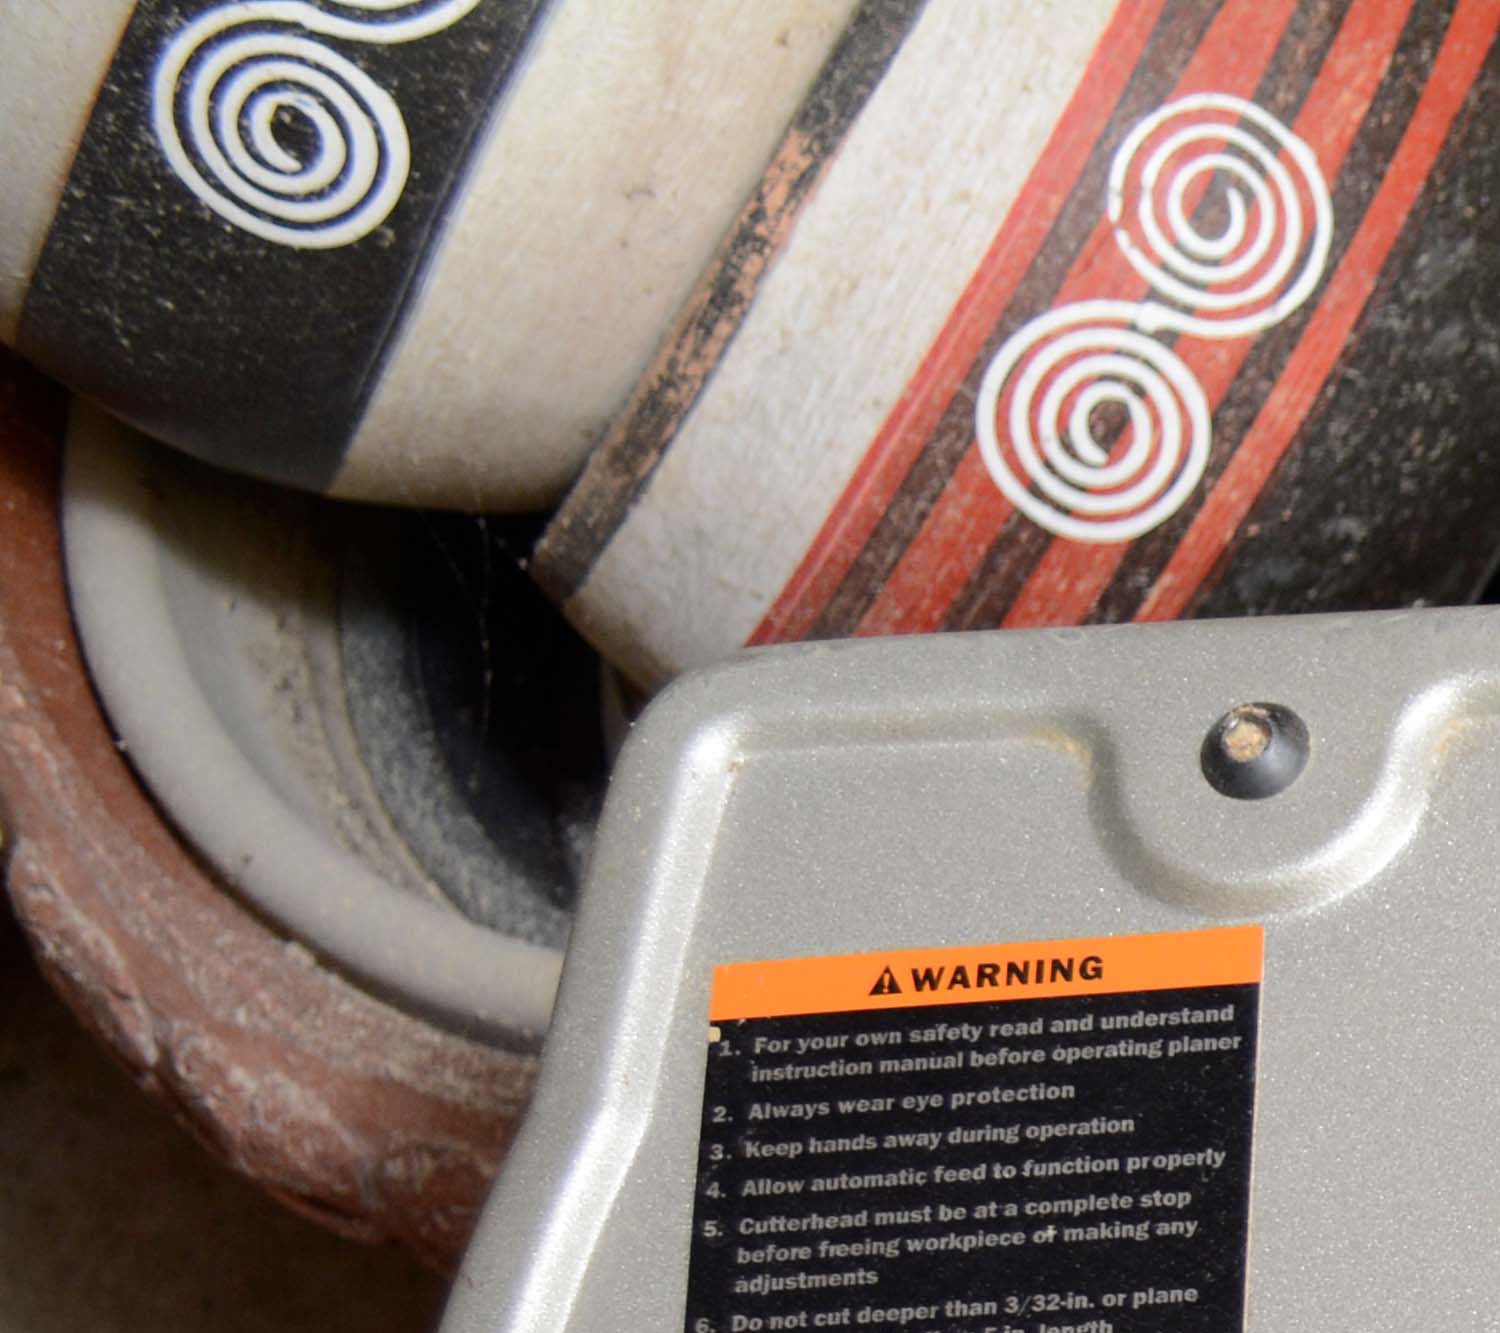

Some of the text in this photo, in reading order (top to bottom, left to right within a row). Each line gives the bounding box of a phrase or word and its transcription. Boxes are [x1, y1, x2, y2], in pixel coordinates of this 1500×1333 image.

[911, 955, 1103, 992] WARNING
[719, 1004, 1234, 1057] 1. For your own safety read and understand
[751, 1035, 1242, 1083] instruction manual before operating planer
[712, 1082, 1075, 1123] 2. Always wear eye protection
[709, 1116, 1135, 1161] 3. Keep hands away during operation
[705, 1148, 1226, 1199] 4. Allow automatic feed to function properly
[703, 1190, 1192, 1238] 5. Cutterhead must be at a complete stop
[736, 1244, 812, 1264] before
[818, 1237, 901, 1258] freeing
[906, 1229, 1026, 1253] workpiece
[1063, 1220, 1150, 1242] making
[1155, 1220, 1198, 1238] any
[734, 1268, 879, 1296] adjustments
[731, 1314, 763, 1333] Do
[770, 1311, 808, 1330] not
[813, 1308, 850, 1327] cut
[856, 1305, 940, 1325] deeper
[944, 1300, 998, 1317] than
[1004, 1291, 1095, 1314] 3/32-in.
[1101, 1293, 1127, 1307] or
[1132, 1287, 1198, 1309] plane
